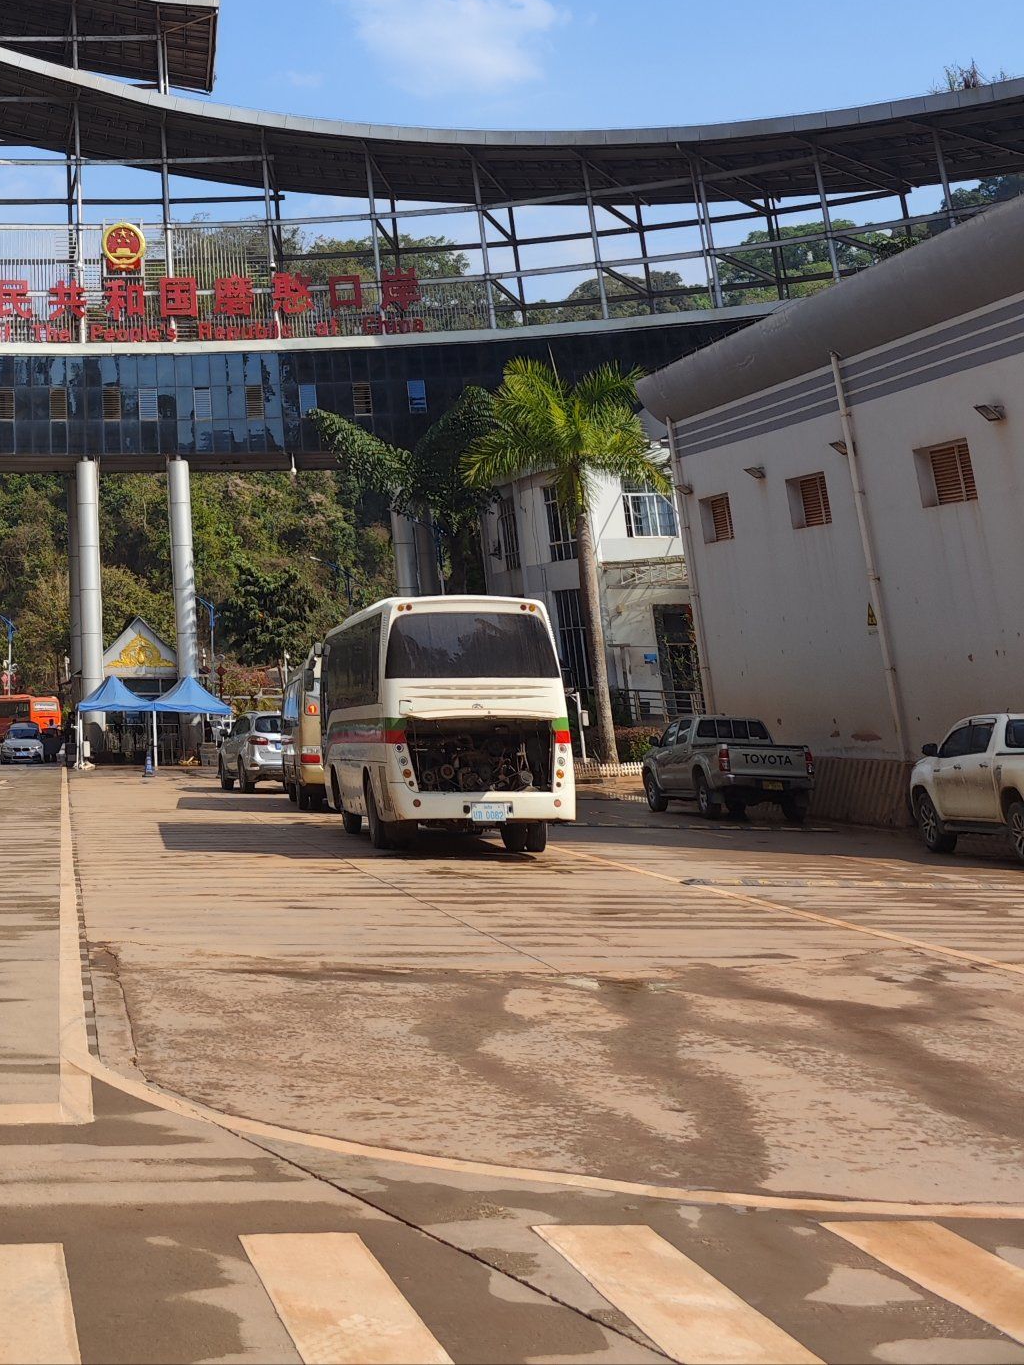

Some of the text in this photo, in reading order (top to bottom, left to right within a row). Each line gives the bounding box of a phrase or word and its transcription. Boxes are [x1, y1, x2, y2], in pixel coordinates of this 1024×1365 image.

[31, 323, 72, 342] The
[90, 324, 177, 342] People's
[315, 317, 342, 337] of
[363, 316, 424, 335] China
[742, 753, 792, 765] TOYOTA
